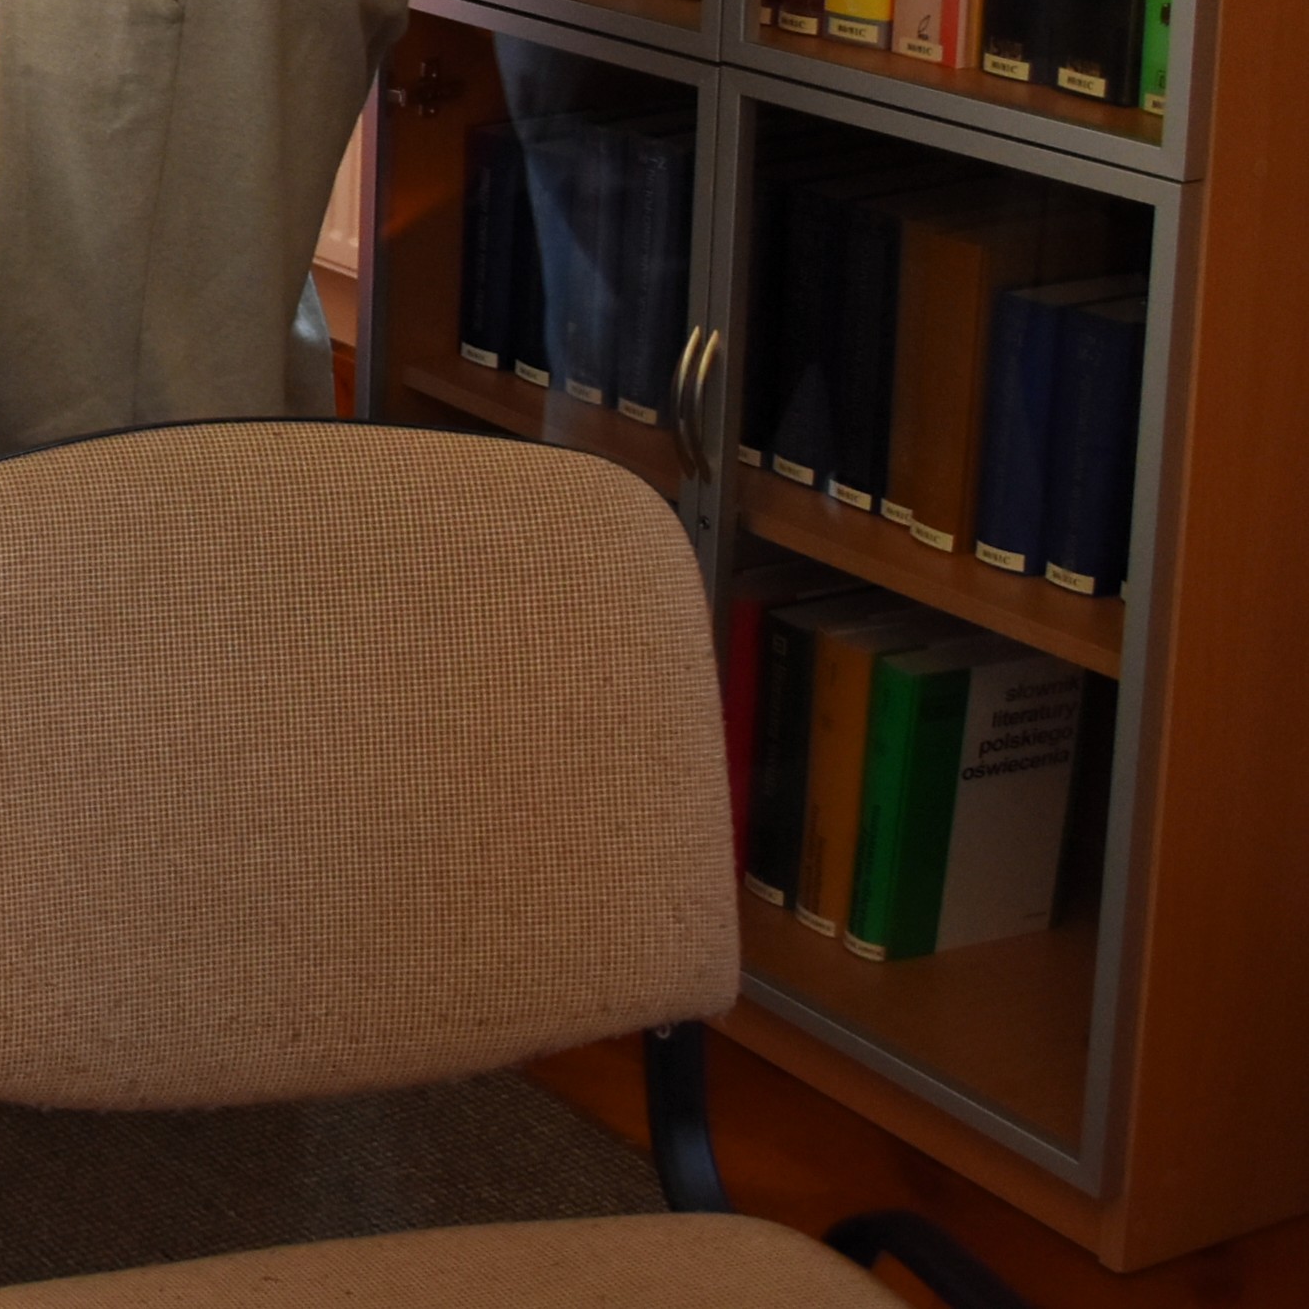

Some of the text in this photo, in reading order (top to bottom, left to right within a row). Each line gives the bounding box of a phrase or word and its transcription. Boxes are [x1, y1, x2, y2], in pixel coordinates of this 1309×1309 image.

[1004, 677, 1081, 703] słownik
[991, 701, 1078, 729] literatury
[978, 727, 1074, 759] polskiego
[961, 747, 1070, 782] oświecenia
